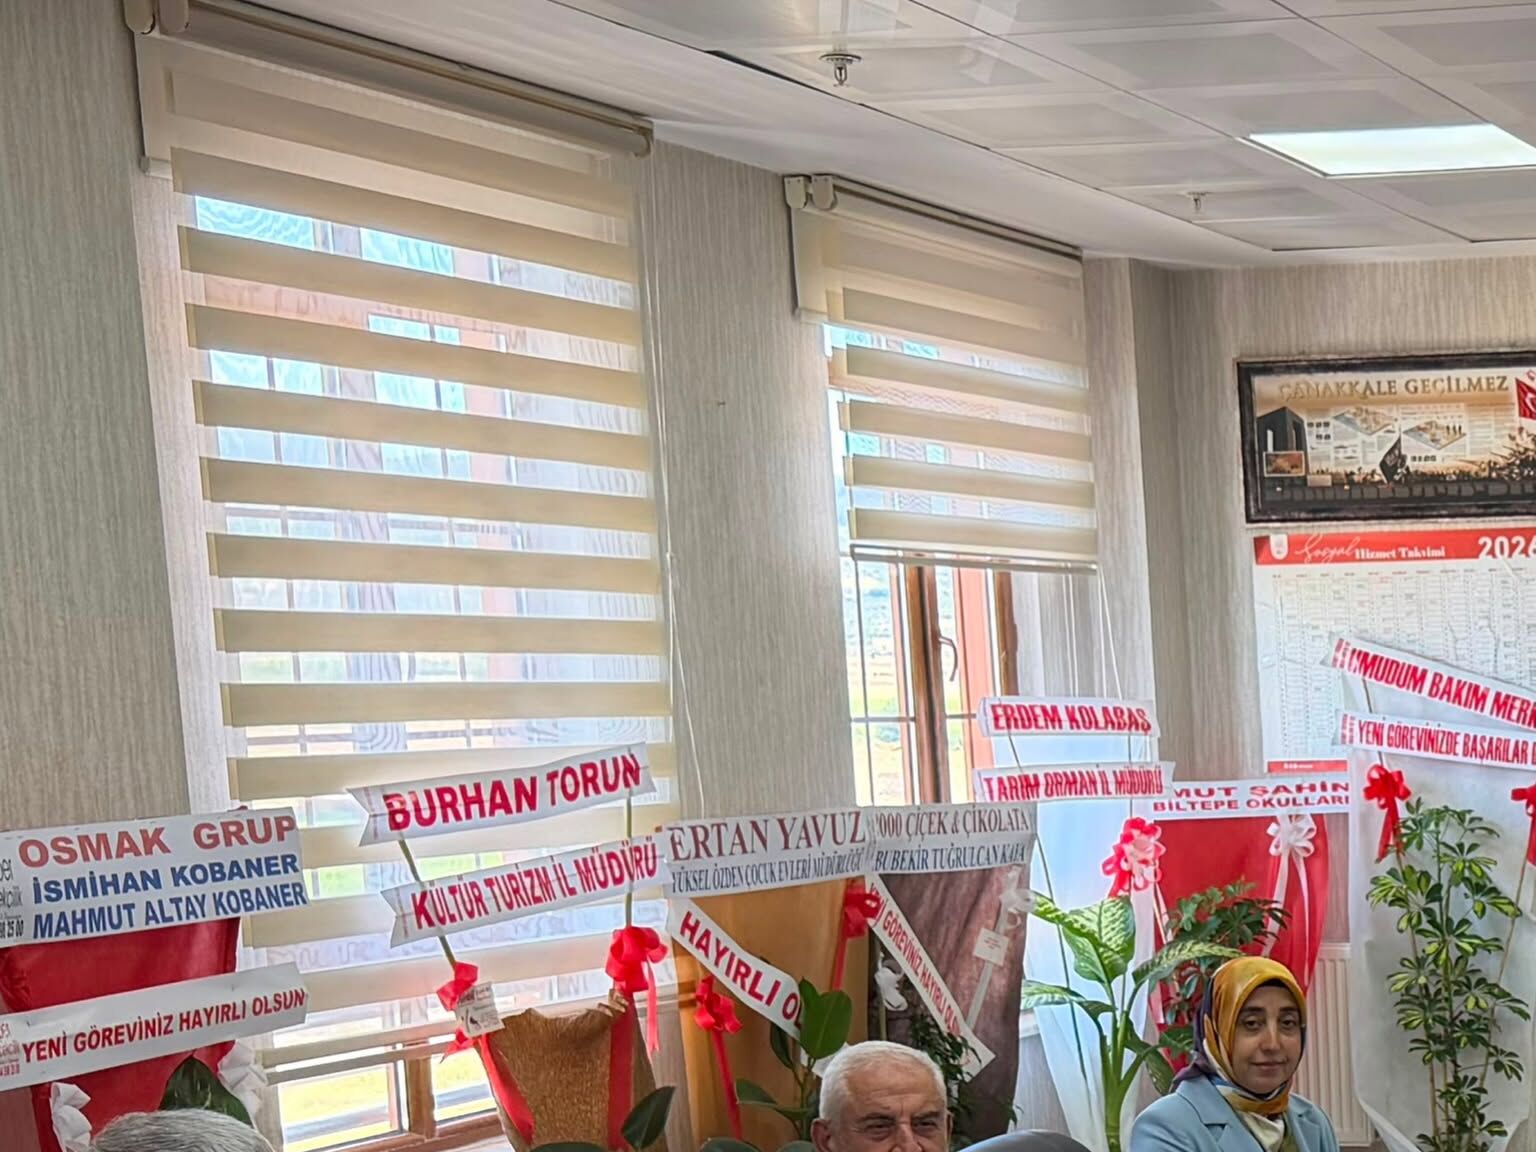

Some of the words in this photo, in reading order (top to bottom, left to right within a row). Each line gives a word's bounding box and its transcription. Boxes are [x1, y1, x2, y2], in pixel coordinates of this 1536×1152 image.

[1280, 378, 1398, 401] ÇANAKKALE
[1404, 375, 1509, 396] GEÇİLMEZ
[1355, 547, 1397, 560] Hizmet
[1399, 546, 1446, 559] Takvimi
[1347, 648, 1428, 698] UMUDUM
[1428, 672, 1490, 716] BAKIM
[990, 704, 1063, 731] ERDEM
[1065, 705, 1152, 736] KOLABAŞ
[1358, 716, 1386, 746] YENİ
[1387, 722, 1460, 756] GÖREVİNİZDE
[1463, 733, 1528, 765] BAŞARILAR
[383, 776, 537, 831] BURHAN
[546, 752, 641, 807] TORUN
[984, 772, 1041, 802] TARIM
[1044, 768, 1098, 797] ORMAN
[1096, 764, 1111, 796] İL
[1113, 766, 1163, 795] MÜDÜRÜ
[1153, 798, 1239, 812] BİLTEPE
[1246, 796, 1349, 809] OKULLARI
[18, 827, 171, 868] OSMAK
[193, 815, 297, 850] GRUP
[667, 818, 769, 861] ERTAN
[776, 811, 866, 850] YAVUZ
[875, 812, 902, 838] 000
[906, 806, 949, 841] ÇİÇEK
[951, 812, 959, 834] &
[962, 804, 1029, 838] ÇİKOLATA
[33, 868, 162, 905] İSMİHAN
[170, 853, 300, 887] KOBANER
[411, 874, 489, 930] KÜLTÜR
[484, 862, 556, 913] TURİZM
[551, 854, 577, 898] İL
[573, 836, 658, 894] MÜDÜRÜ
[672, 865, 712, 894] YÜKSEL
[713, 863, 745, 892] ÖZDEN
[745, 861, 778, 888] ÇOCUK
[778, 853, 811, 882] EVLERİ
[874, 845, 929, 871] BUBEKİR
[33, 903, 136, 939] MAHMUT
[144, 894, 207, 926] ALTAY
[213, 882, 308, 916] KOBANER
[679, 911, 781, 1007] HAYIRLI
[882, 908, 925, 977] GÖREVİNİZ
[919, 966, 948, 1016] HAYIRLI
[22, 1032, 68, 1063] YENİ
[73, 1012, 174, 1053] GÖREVİNİZ
[179, 1000, 246, 1031] HAYIRLI
[252, 988, 306, 1017] OLSUN
